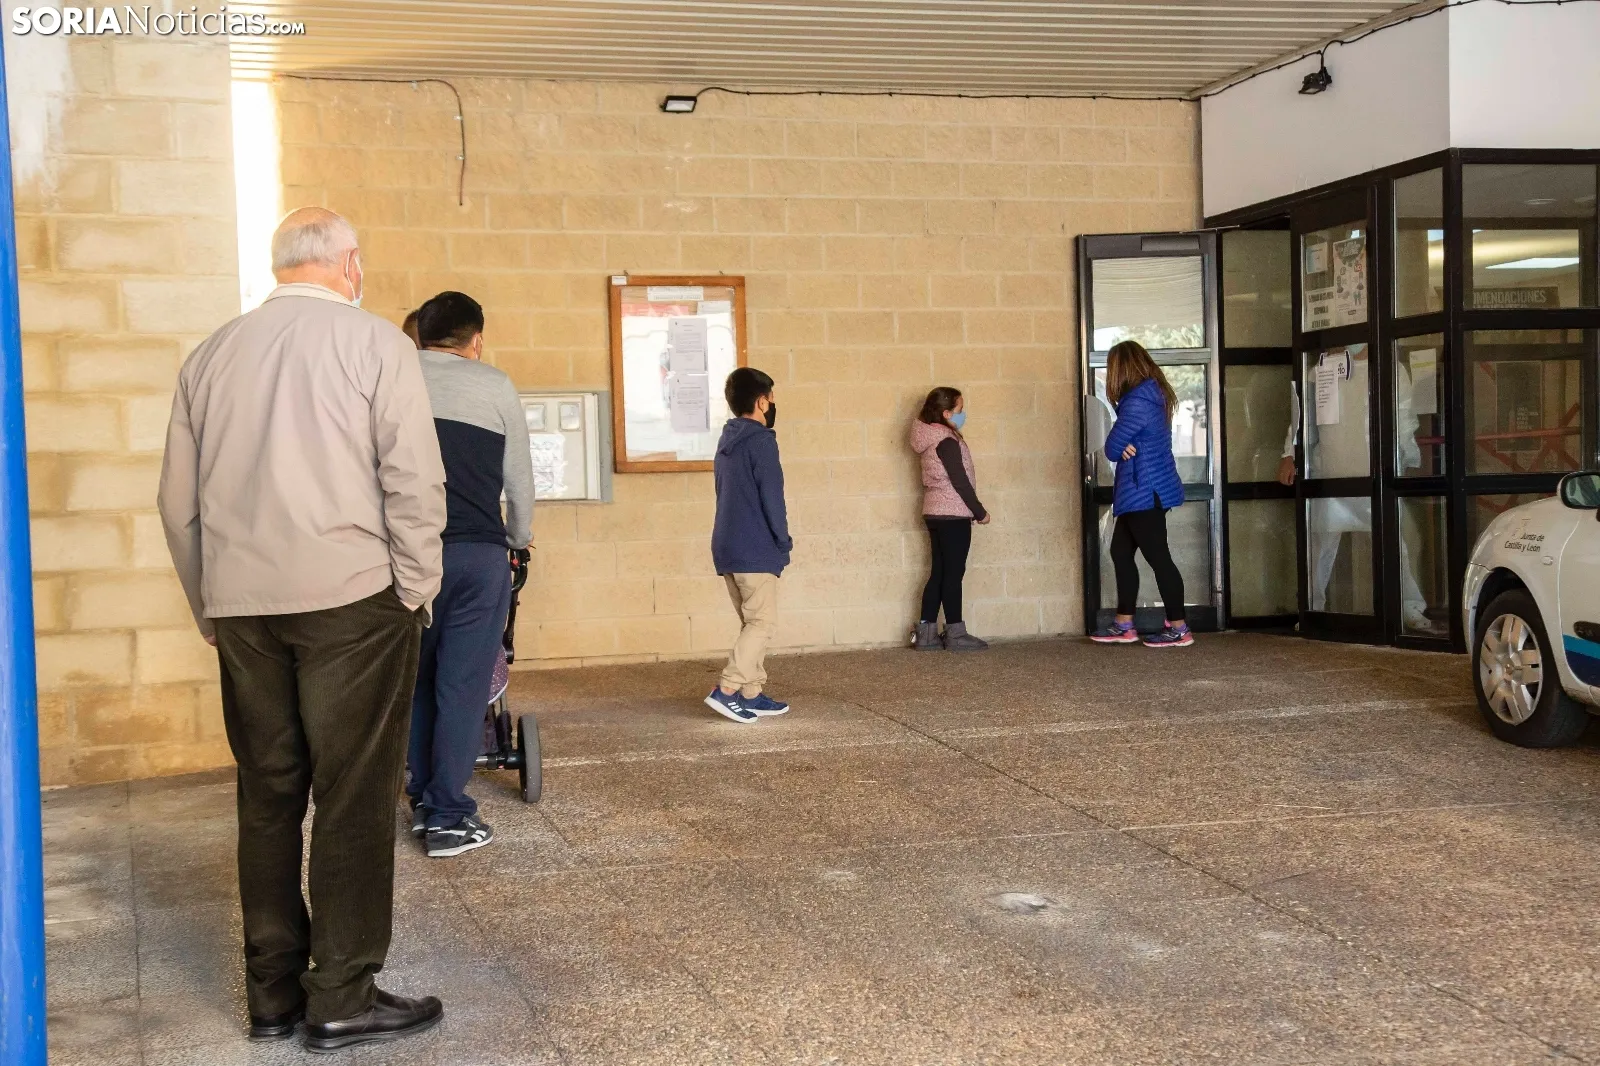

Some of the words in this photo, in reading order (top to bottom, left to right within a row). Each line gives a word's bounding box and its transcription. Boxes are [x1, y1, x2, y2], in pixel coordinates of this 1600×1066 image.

[1520, 532, 1537, 541] Junta
[1536, 534, 1545, 542] de
[1505, 541, 1522, 549] Castilla
[1521, 544, 1527, 552] y
[1527, 543, 1541, 552] León
